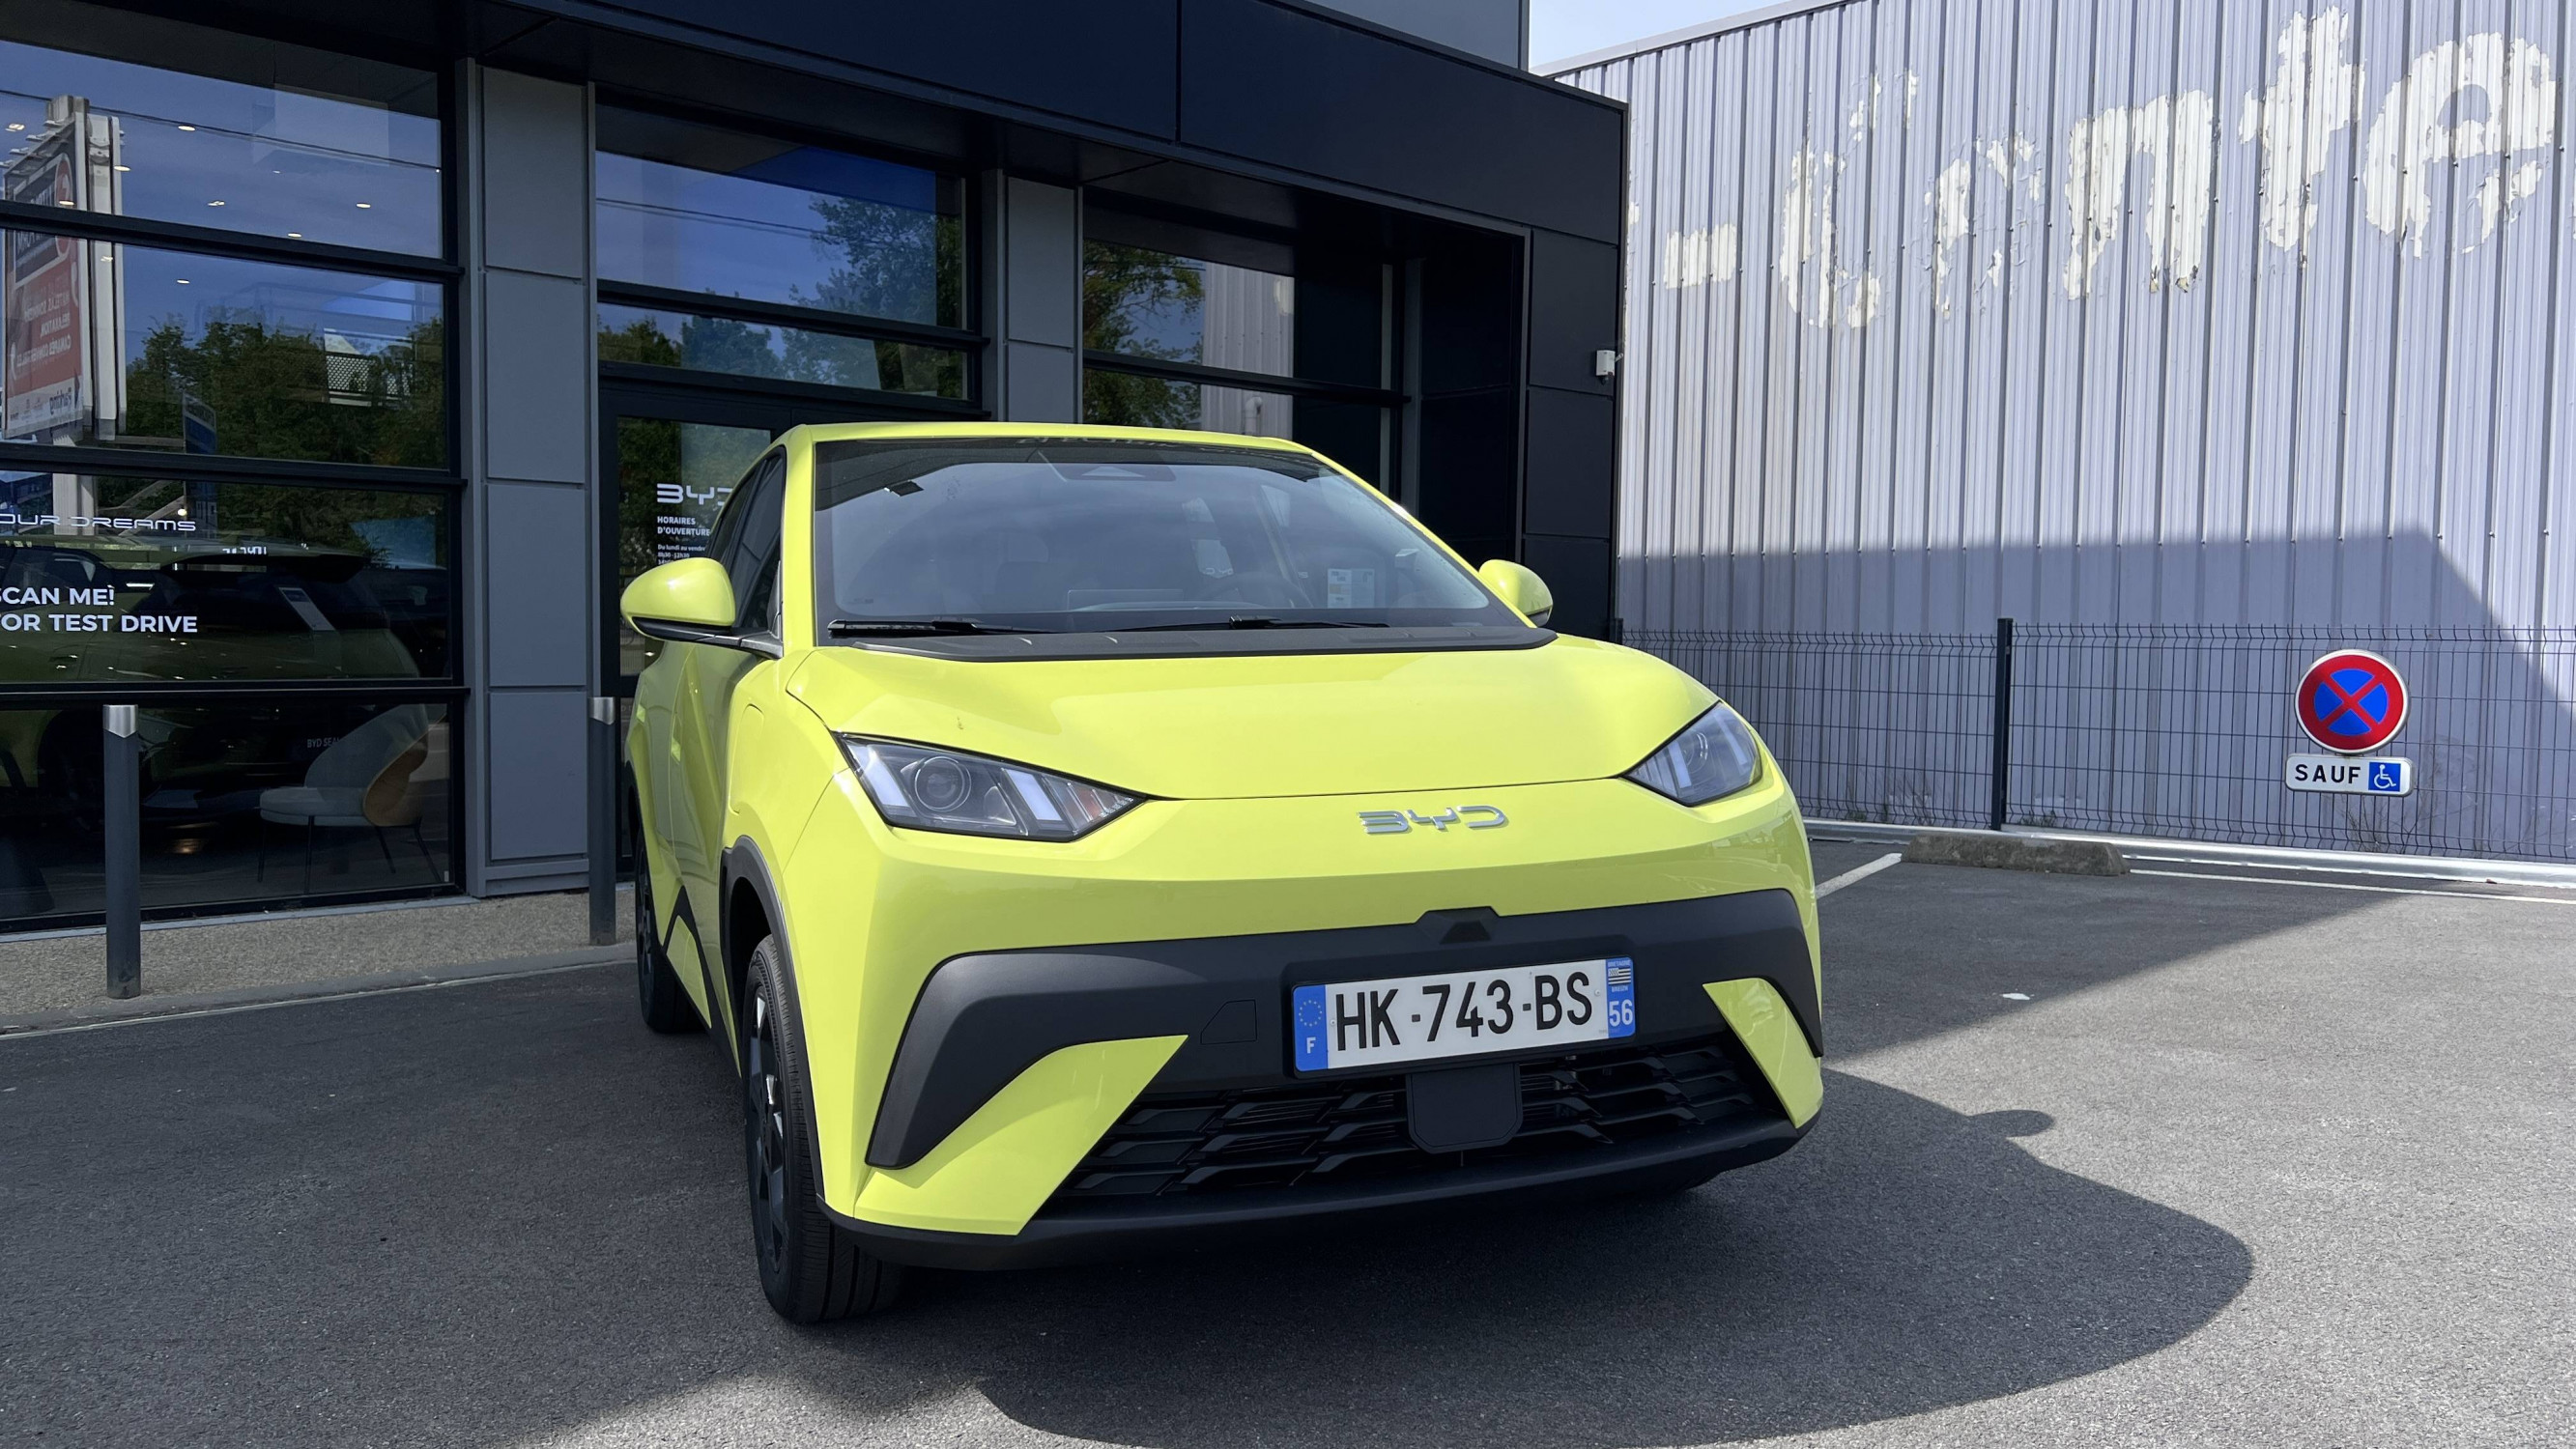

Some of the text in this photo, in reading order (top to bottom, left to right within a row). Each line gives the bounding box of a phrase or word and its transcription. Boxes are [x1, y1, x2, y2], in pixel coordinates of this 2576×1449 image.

[69, 516, 197, 531] DREAMS
[657, 516, 696, 525] HORAIRES
[657, 527, 710, 536] D'OUVERTURE
[0, 586, 115, 606] CAN ME!
[0, 613, 198, 633] OR TEST DRIVE
[307, 738, 322, 748] BYD
[2294, 763, 2361, 784] SAUF
[1358, 805, 1505, 835] BYD
[1306, 971, 1593, 1055] F HK-743-BS
[1608, 998, 1634, 1028] 56
